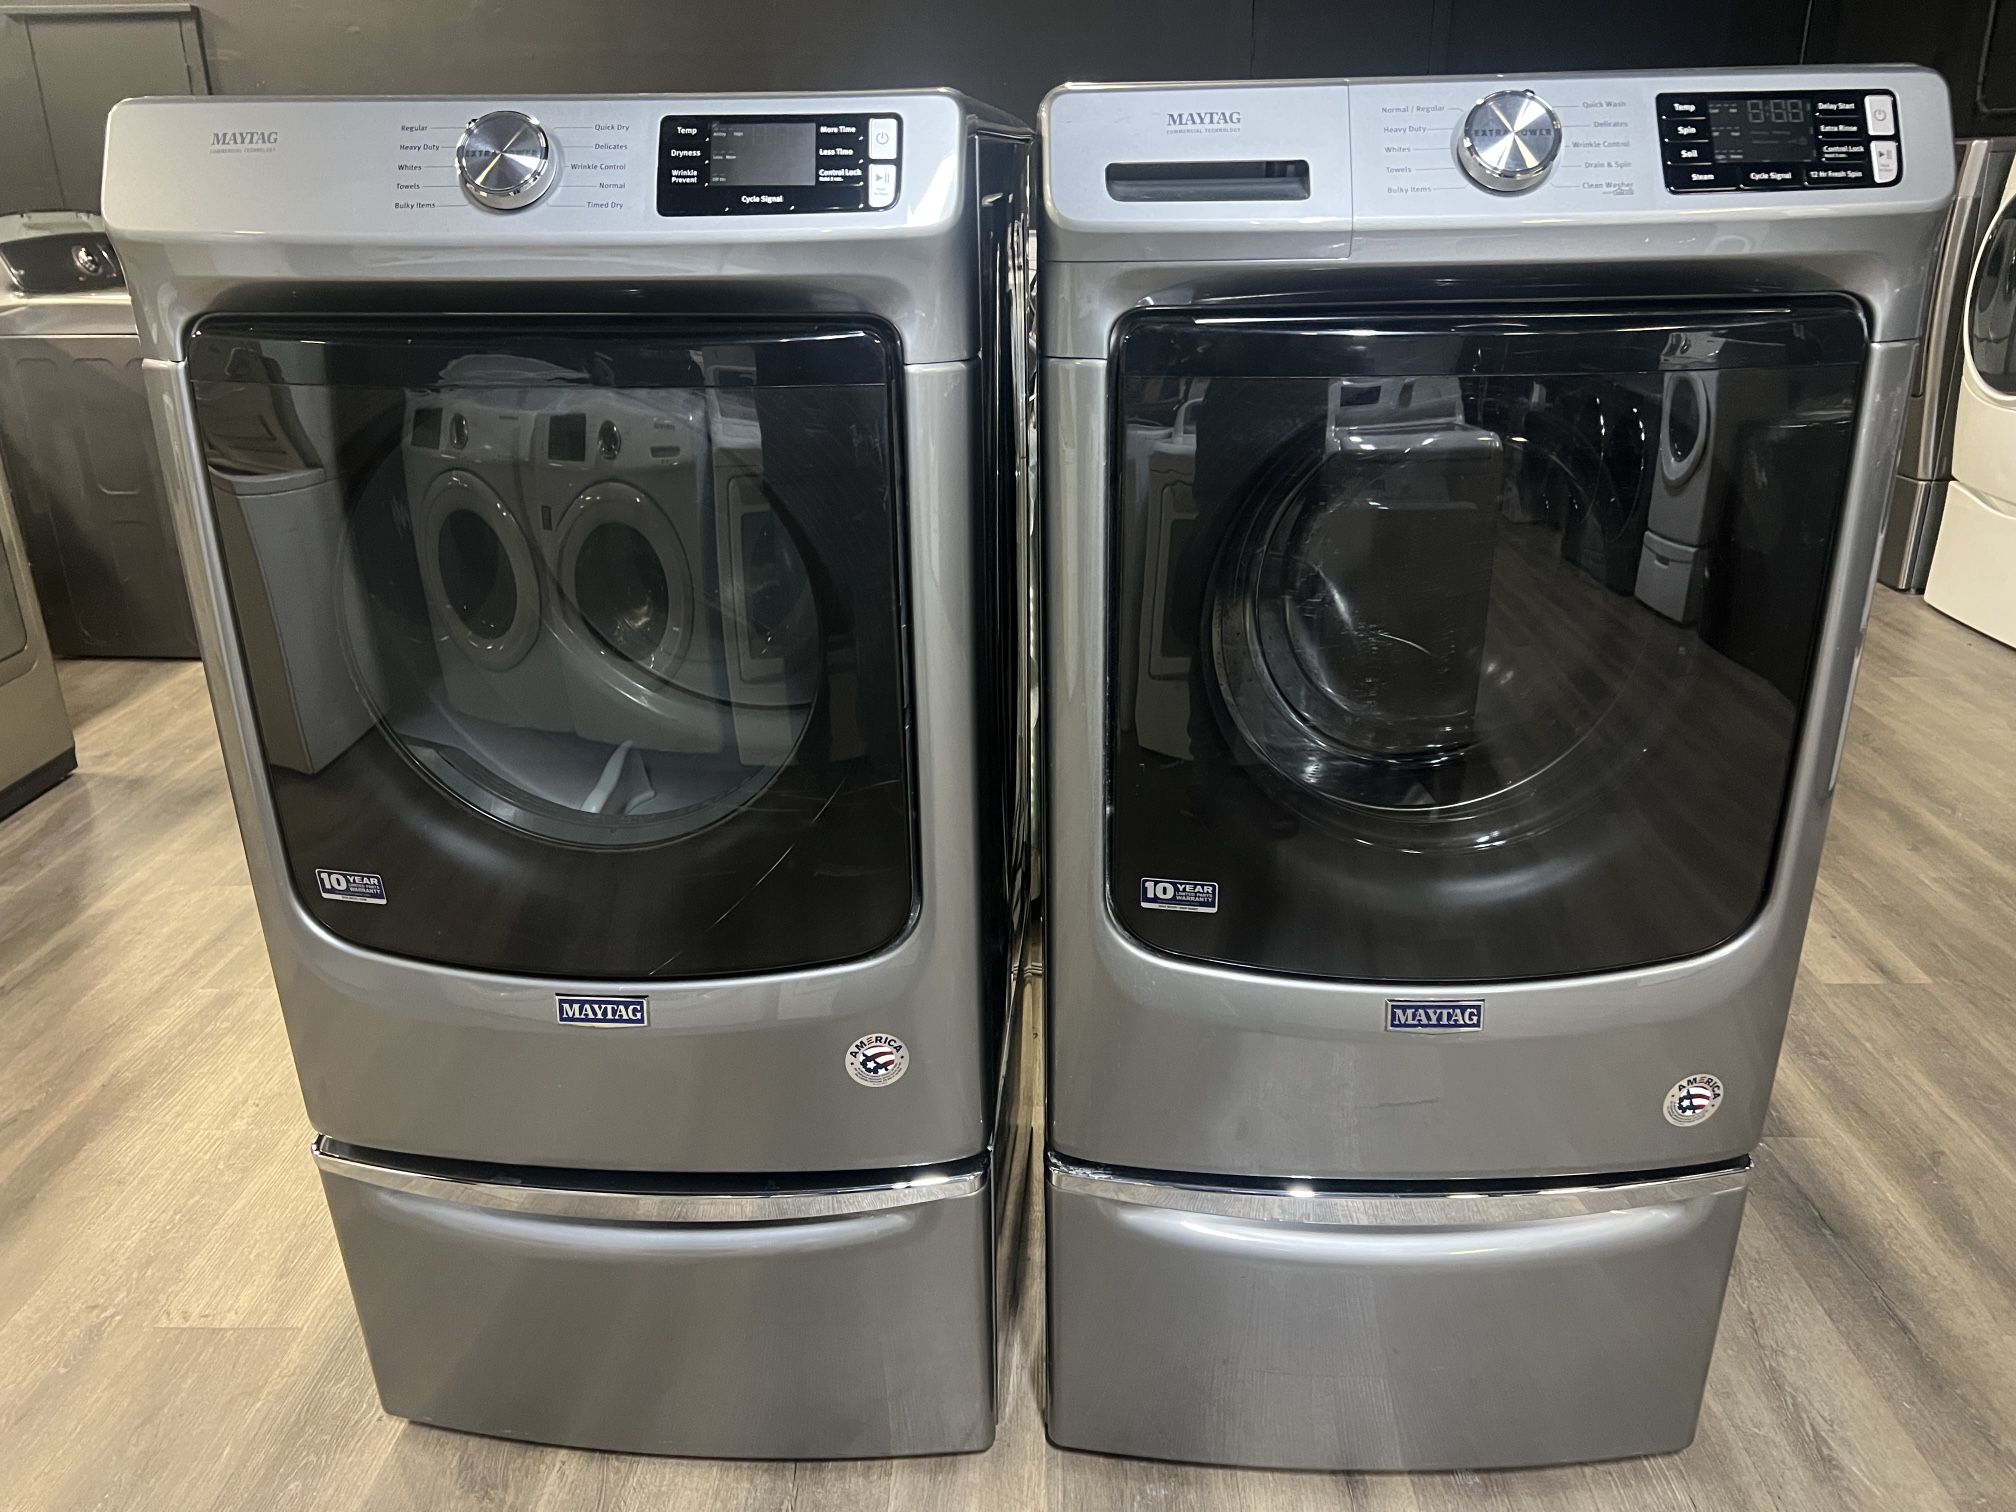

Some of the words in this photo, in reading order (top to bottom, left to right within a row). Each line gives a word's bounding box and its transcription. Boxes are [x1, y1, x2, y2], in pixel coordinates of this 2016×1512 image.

[1416, 105, 1445, 113] Regular
[1673, 103, 1696, 112] Temp
[1838, 102, 1855, 110] Start
[1167, 112, 1241, 126] MAYTAG
[617, 124, 630, 132] Dry
[677, 127, 698, 135] Temp
[1677, 126, 1697, 135] Spin
[211, 132, 278, 145] MAYTAG
[671, 149, 702, 158] Dryness
[836, 148, 853, 156] Time
[1680, 149, 1698, 158] Soil
[1691, 173, 1715, 181] Steam
[1769, 172, 1792, 180] Signal
[1387, 186, 1409, 194] Bulky
[741, 195, 760, 204] Cycle
[760, 195, 783, 204] Signal
[394, 202, 415, 210] Bulky
[610, 201, 624, 210] Dry
[321, 873, 347, 890] 10
[347, 876, 378, 885] YEAR
[1144, 881, 1174, 899] 10
[1176, 884, 1213, 893] YEAR
[561, 1003, 642, 1019] MAYTAG
[1393, 1008, 1478, 1024] MAYTAG
[849, 1035, 903, 1058] AMERICA
[1678, 1076, 1721, 1100] AMERICA
